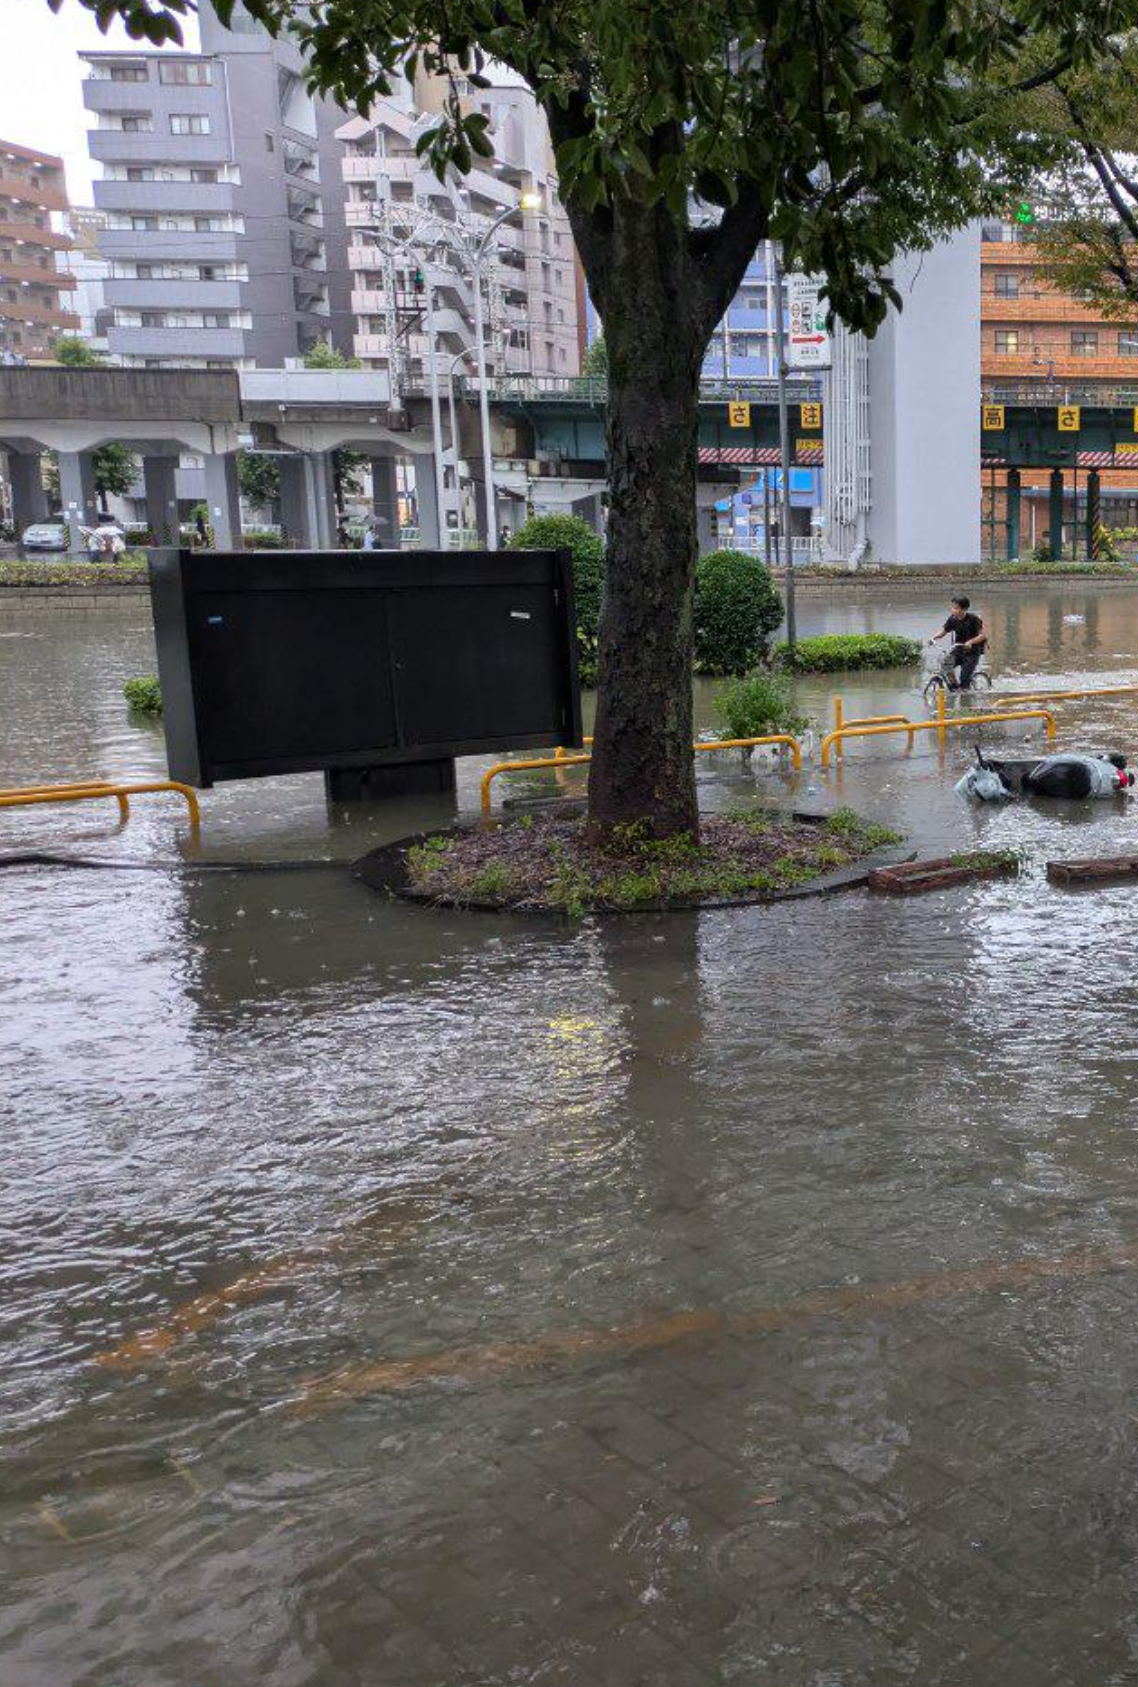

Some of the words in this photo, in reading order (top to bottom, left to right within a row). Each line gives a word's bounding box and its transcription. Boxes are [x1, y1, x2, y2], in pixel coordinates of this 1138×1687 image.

[733, 406, 746, 424] さ
[803, 405, 818, 424] 注
[985, 407, 1001, 427] 高
[1062, 410, 1077, 427] さ
